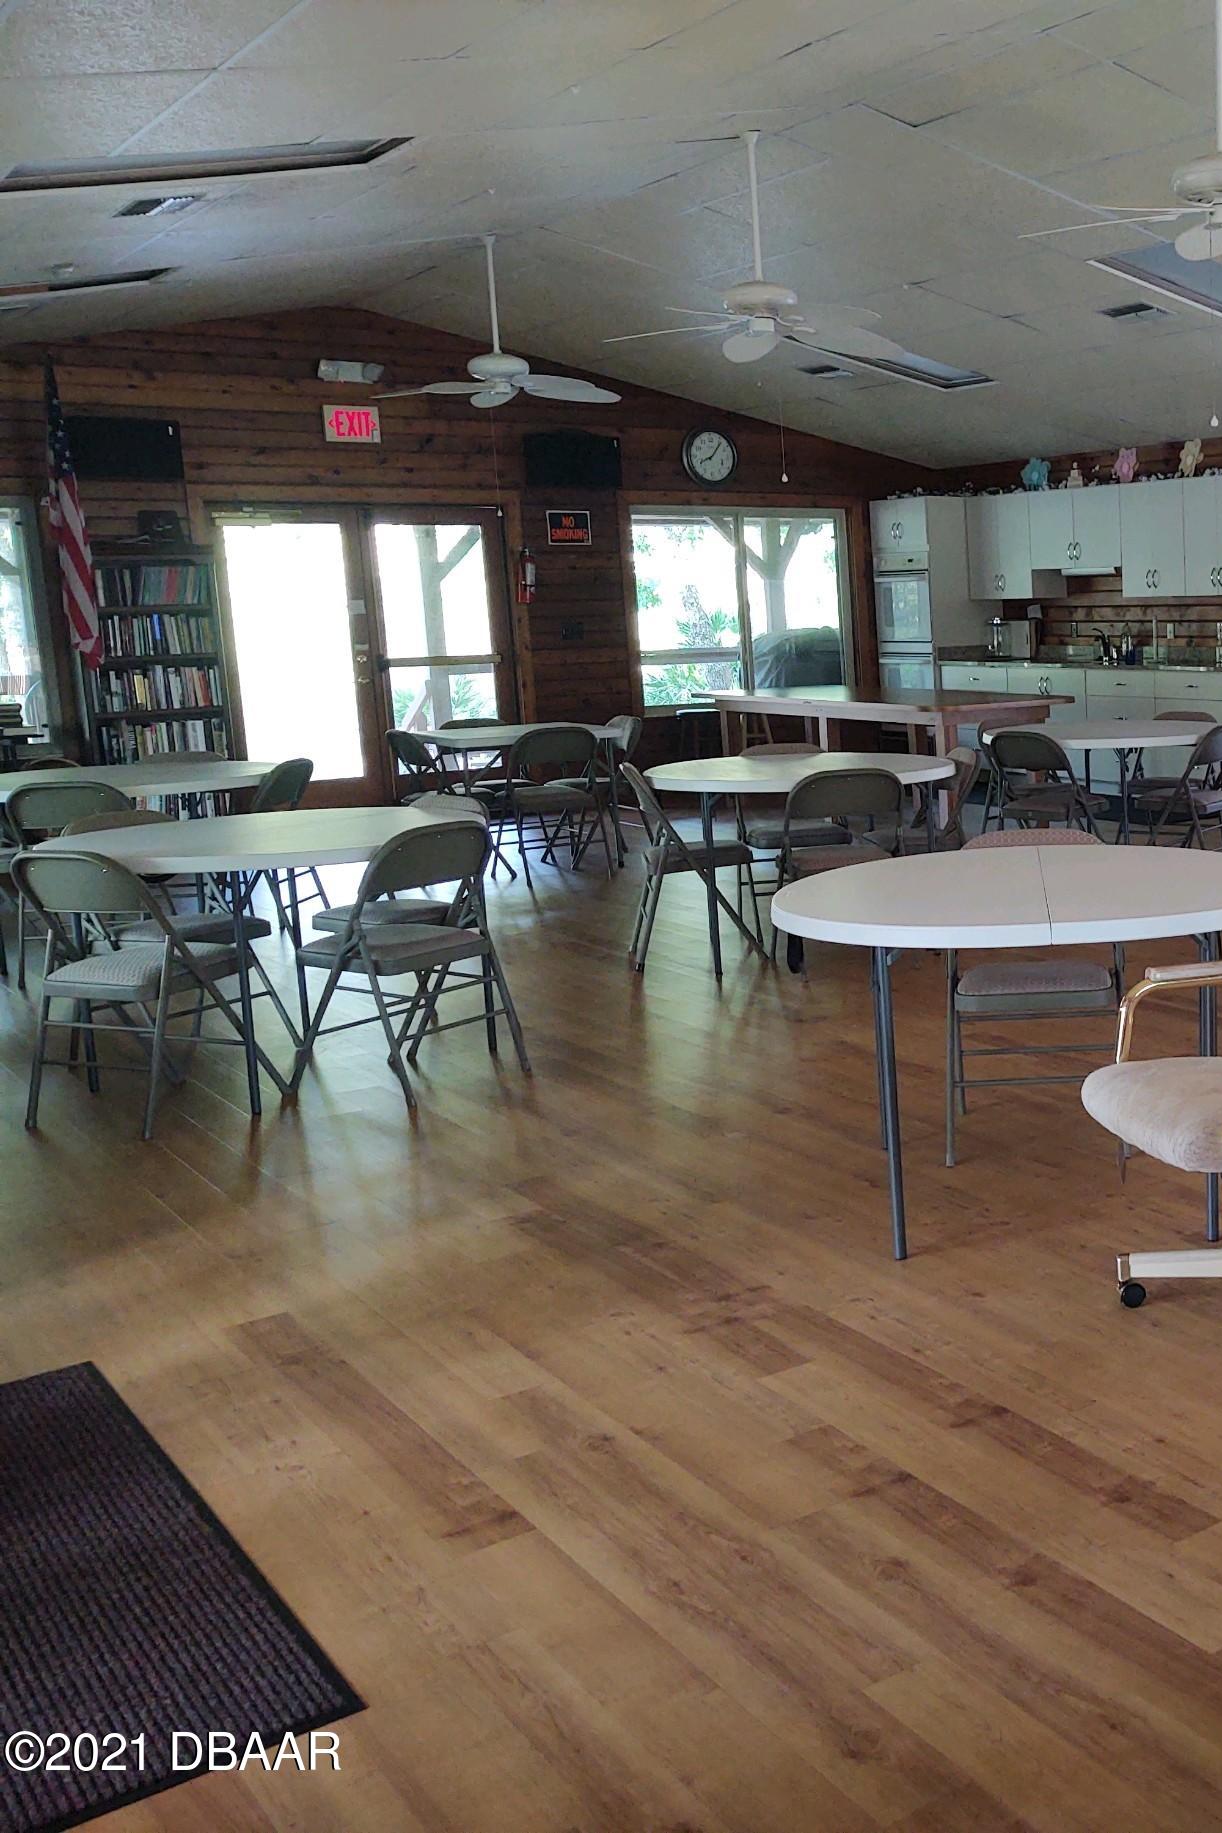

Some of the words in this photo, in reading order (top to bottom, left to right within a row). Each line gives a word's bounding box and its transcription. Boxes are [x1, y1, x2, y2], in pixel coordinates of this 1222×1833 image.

[335, 410, 371, 437] EXIT
[562, 515, 575, 528] NO
[551, 528, 588, 540] SMOKING
